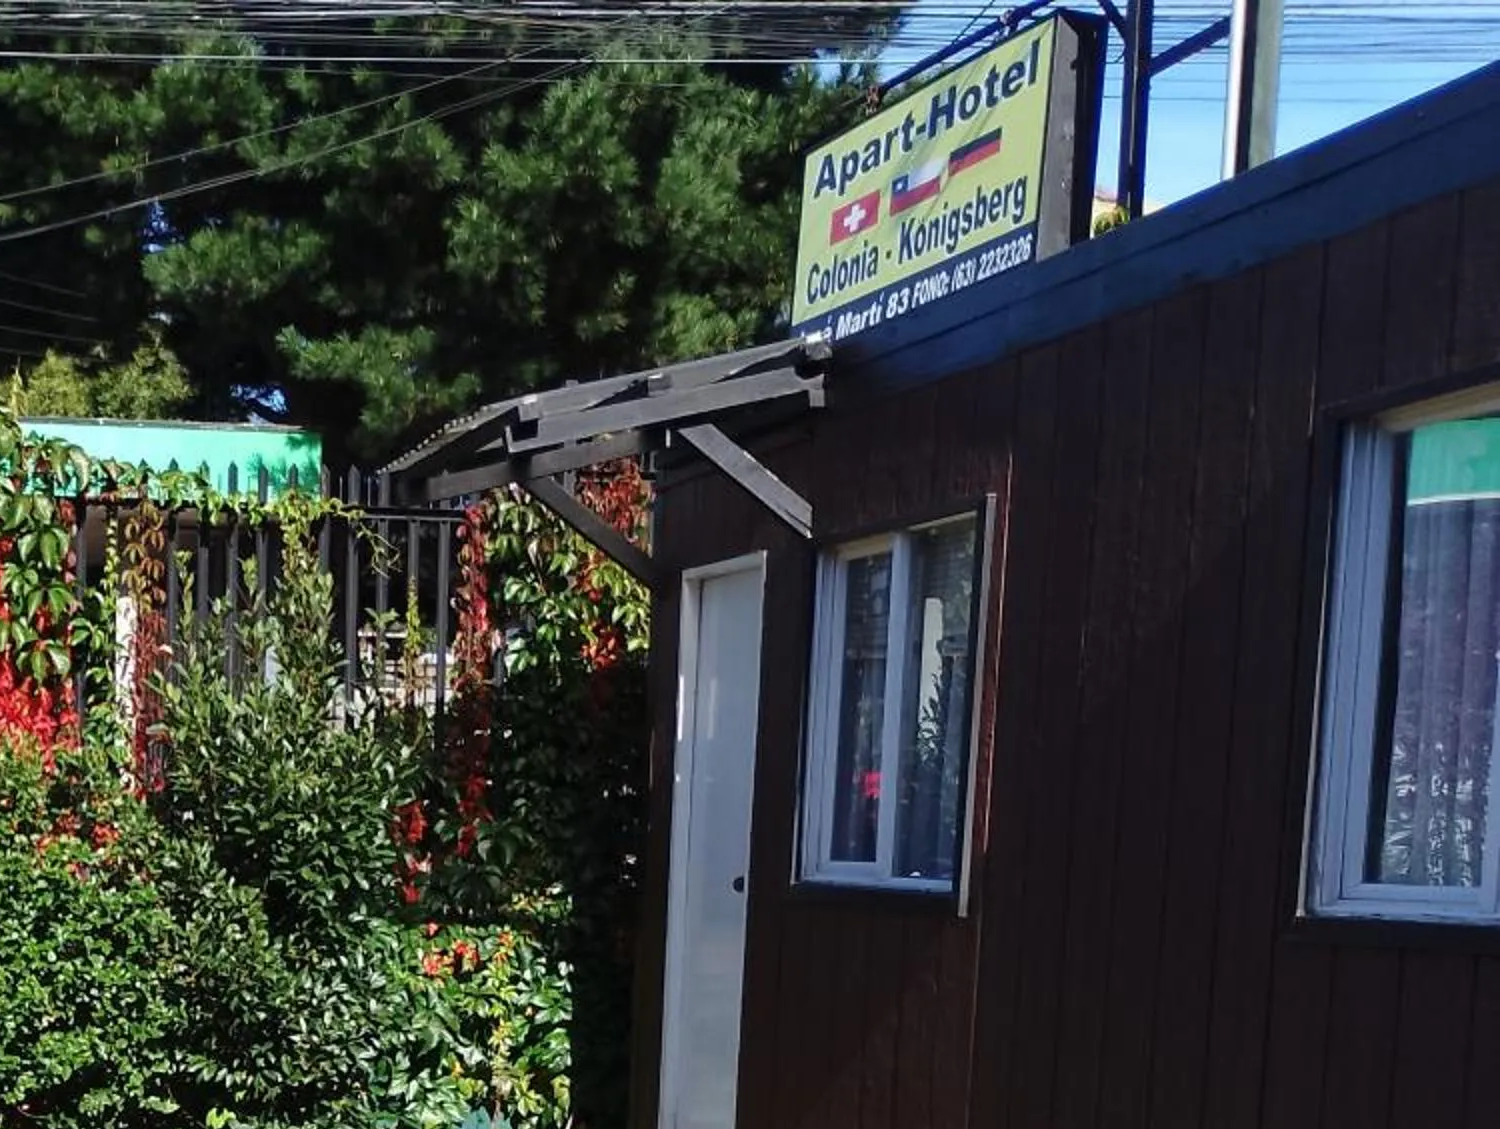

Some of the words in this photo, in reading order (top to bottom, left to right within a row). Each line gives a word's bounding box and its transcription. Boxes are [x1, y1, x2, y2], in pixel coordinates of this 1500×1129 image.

[814, 38, 1041, 198] Apart-Hotel
[807, 240, 879, 304] Colonia
[899, 176, 1028, 264] Königsberg
[836, 293, 884, 338] Martí
[886, 287, 910, 318] 83
